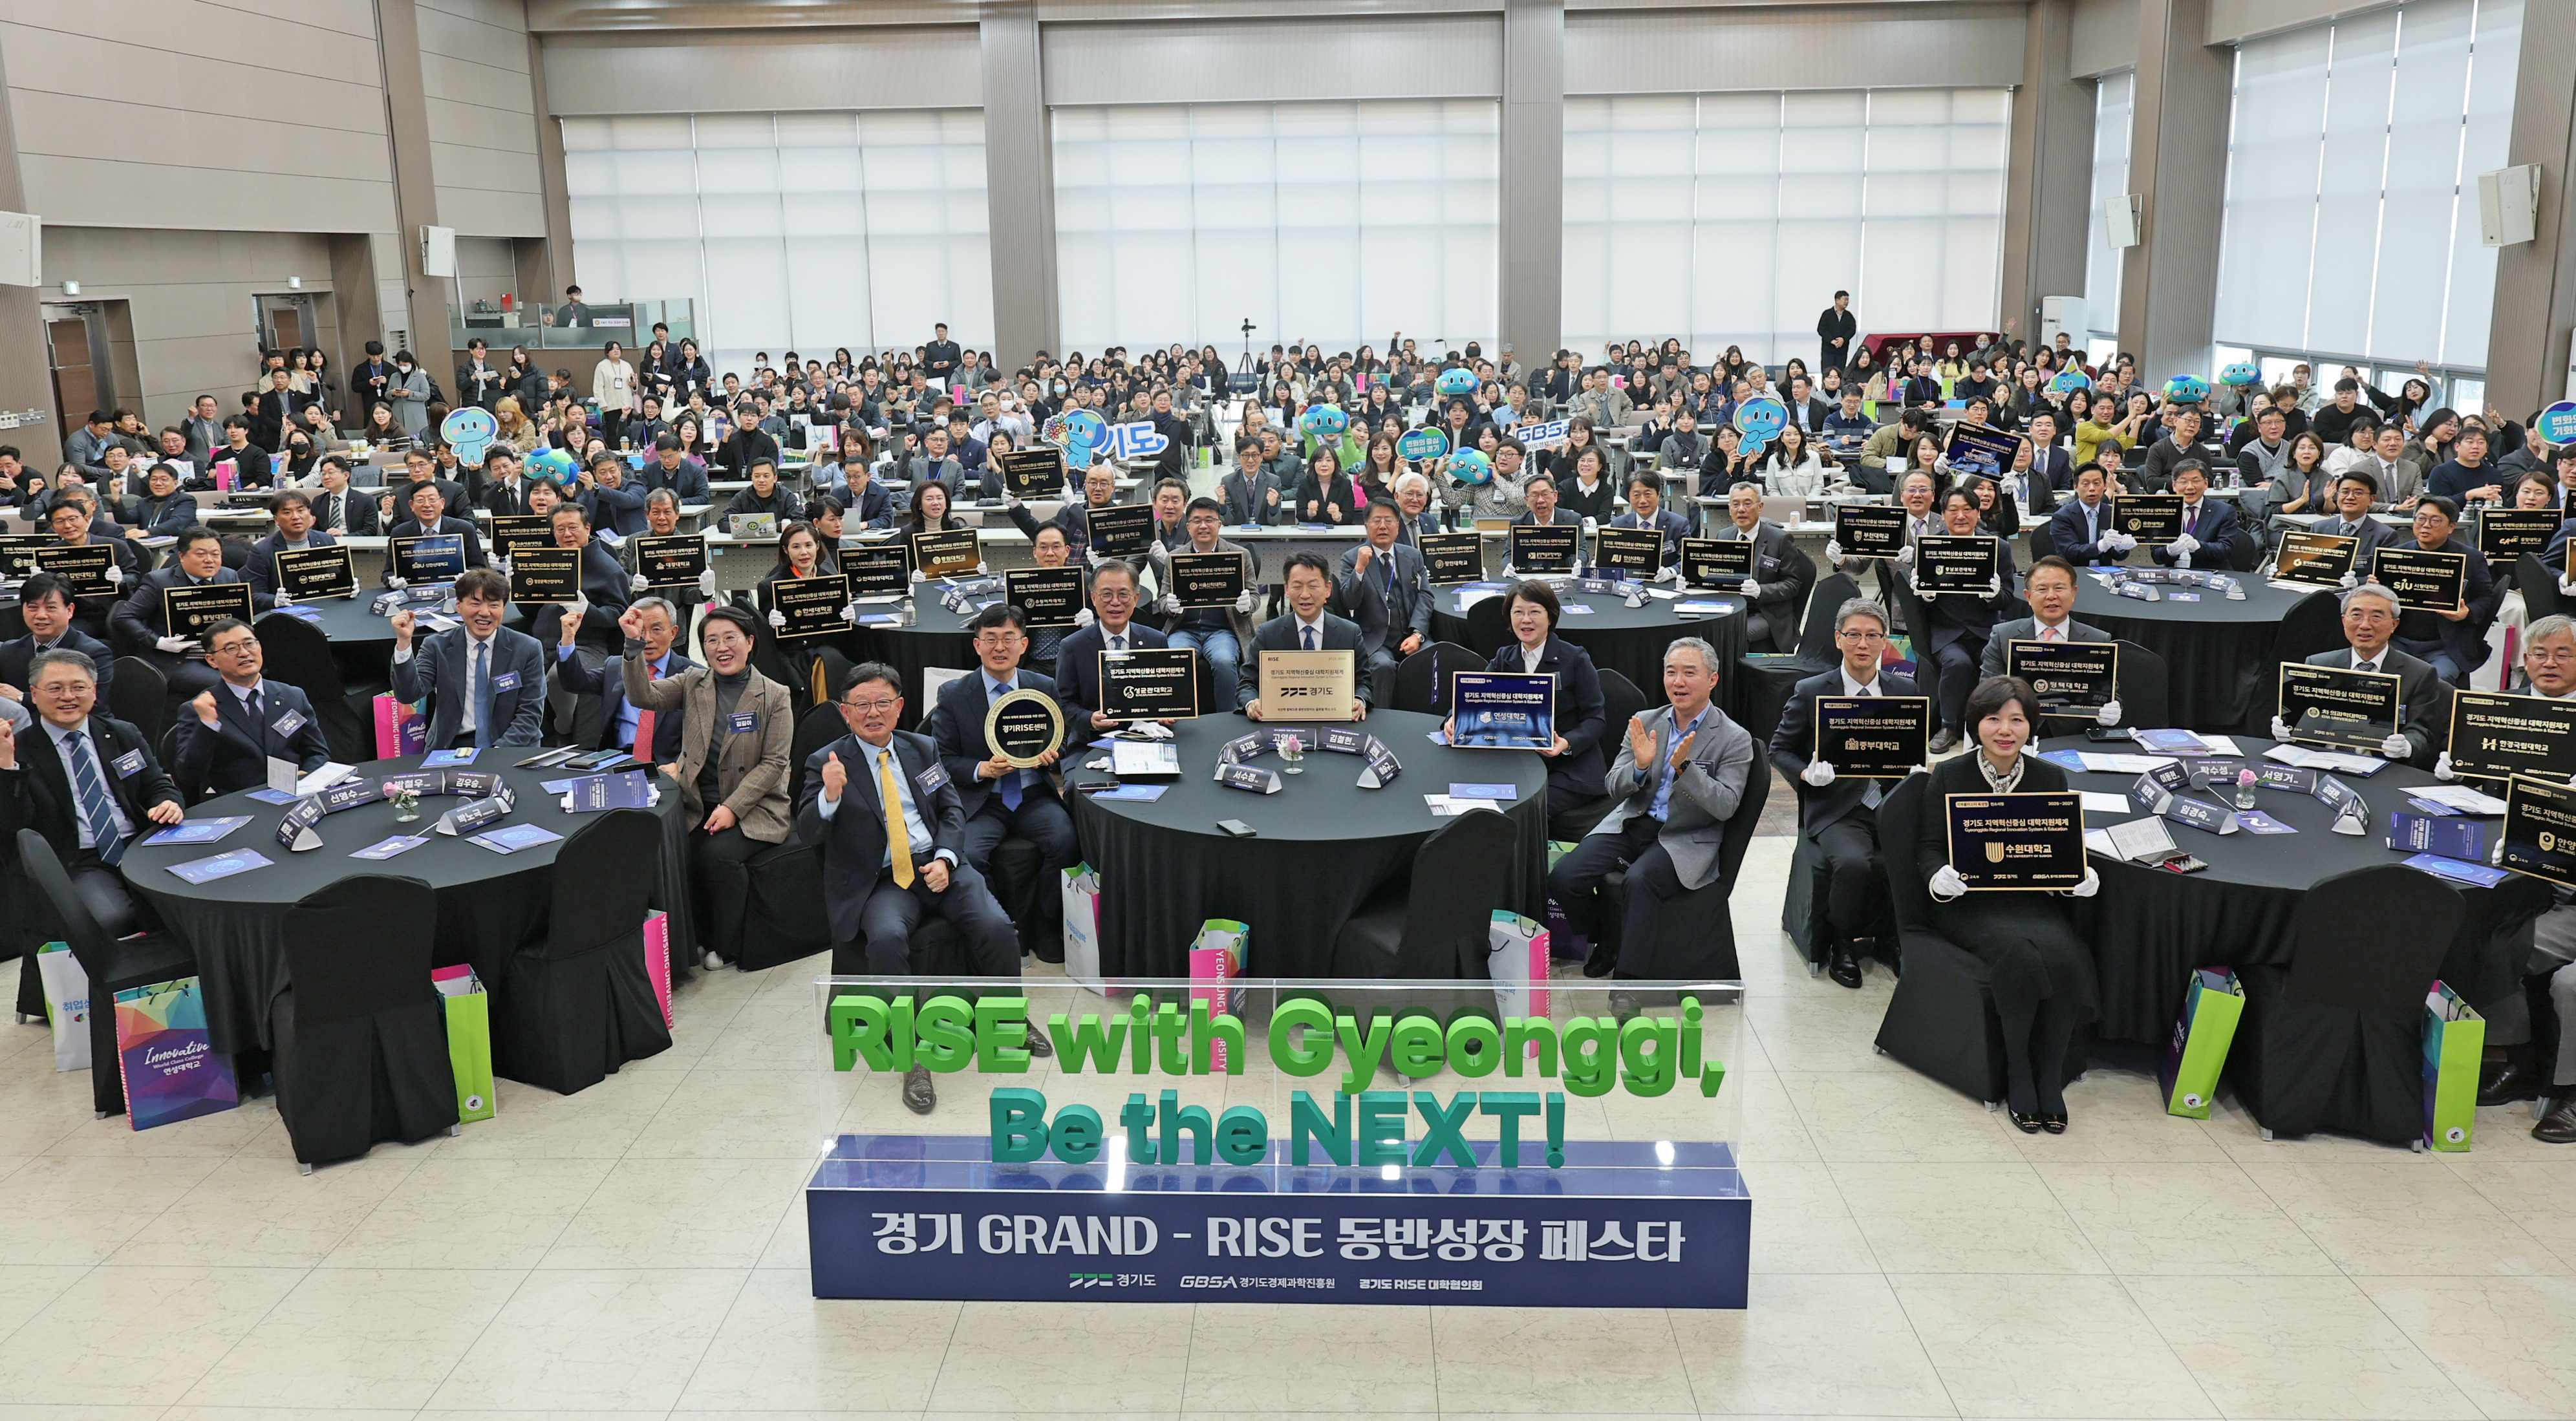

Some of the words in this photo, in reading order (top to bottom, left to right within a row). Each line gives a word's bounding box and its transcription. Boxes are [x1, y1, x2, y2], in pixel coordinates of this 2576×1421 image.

[1407, 447, 1426, 455] 기회의
[1310, 687, 1333, 696] 경기도
[2312, 687, 2347, 697] 지역혁신중심
[2348, 692, 2385, 702] 대학지원체계
[2330, 710, 2368, 720] 의과학대학교
[1002, 723, 1047, 733] 경기RISE센터
[2487, 716, 2527, 725] 지역혁신중심
[2528, 720, 2570, 730] 대학지원체계
[1329, 734, 1352, 745] 김철현
[2500, 740, 2549, 751] 한경국립대학교
[1859, 742, 1900, 751] 중부대학교
[456, 778, 479, 788] 김우승
[1233, 771, 1256, 782] 서수정
[2262, 770, 2293, 783] 서영거
[330, 789, 358, 804] 신영수
[2180, 805, 2208, 820] 임경숙
[2521, 803, 2542, 815] 경기도
[2006, 844, 2052, 854] 수원대학교
[661, 915, 670, 968] YEONSUNG
[1216, 951, 1225, 1007] YEONSUNG
[664, 972, 674, 1027] UNIVERSITY
[144, 1040, 209, 1065] Innovative
[830, 995, 1031, 1074] RISE
[1047, 994, 1245, 1075] with
[1269, 996, 1726, 1098] Gyeonggi,
[153, 1062, 169, 1070] World
[170, 1057, 185, 1066] Class
[186, 1053, 204, 1062] College
[163, 1061, 201, 1076] 연성대학교
[989, 1087, 1103, 1164] Be
[1120, 1089, 1268, 1166] the
[1291, 1090, 1565, 1169] NEXT!
[871, 1212, 963, 1255] 경기
[978, 1213, 1159, 1256] GRAND
[1207, 1217, 1324, 1257] RISE
[1336, 1217, 1529, 1261] 동반성장
[1539, 1219, 1686, 1263] 페스타
[1116, 1274, 1157, 1287] 경기도
[1180, 1276, 1238, 1289] GBSA
[1239, 1277, 1336, 1290] 경기도경제과학진흥원
[1359, 1278, 1393, 1290] 경기도
[1394, 1279, 1426, 1290] RISE
[1428, 1279, 1483, 1291] 대학협의회
